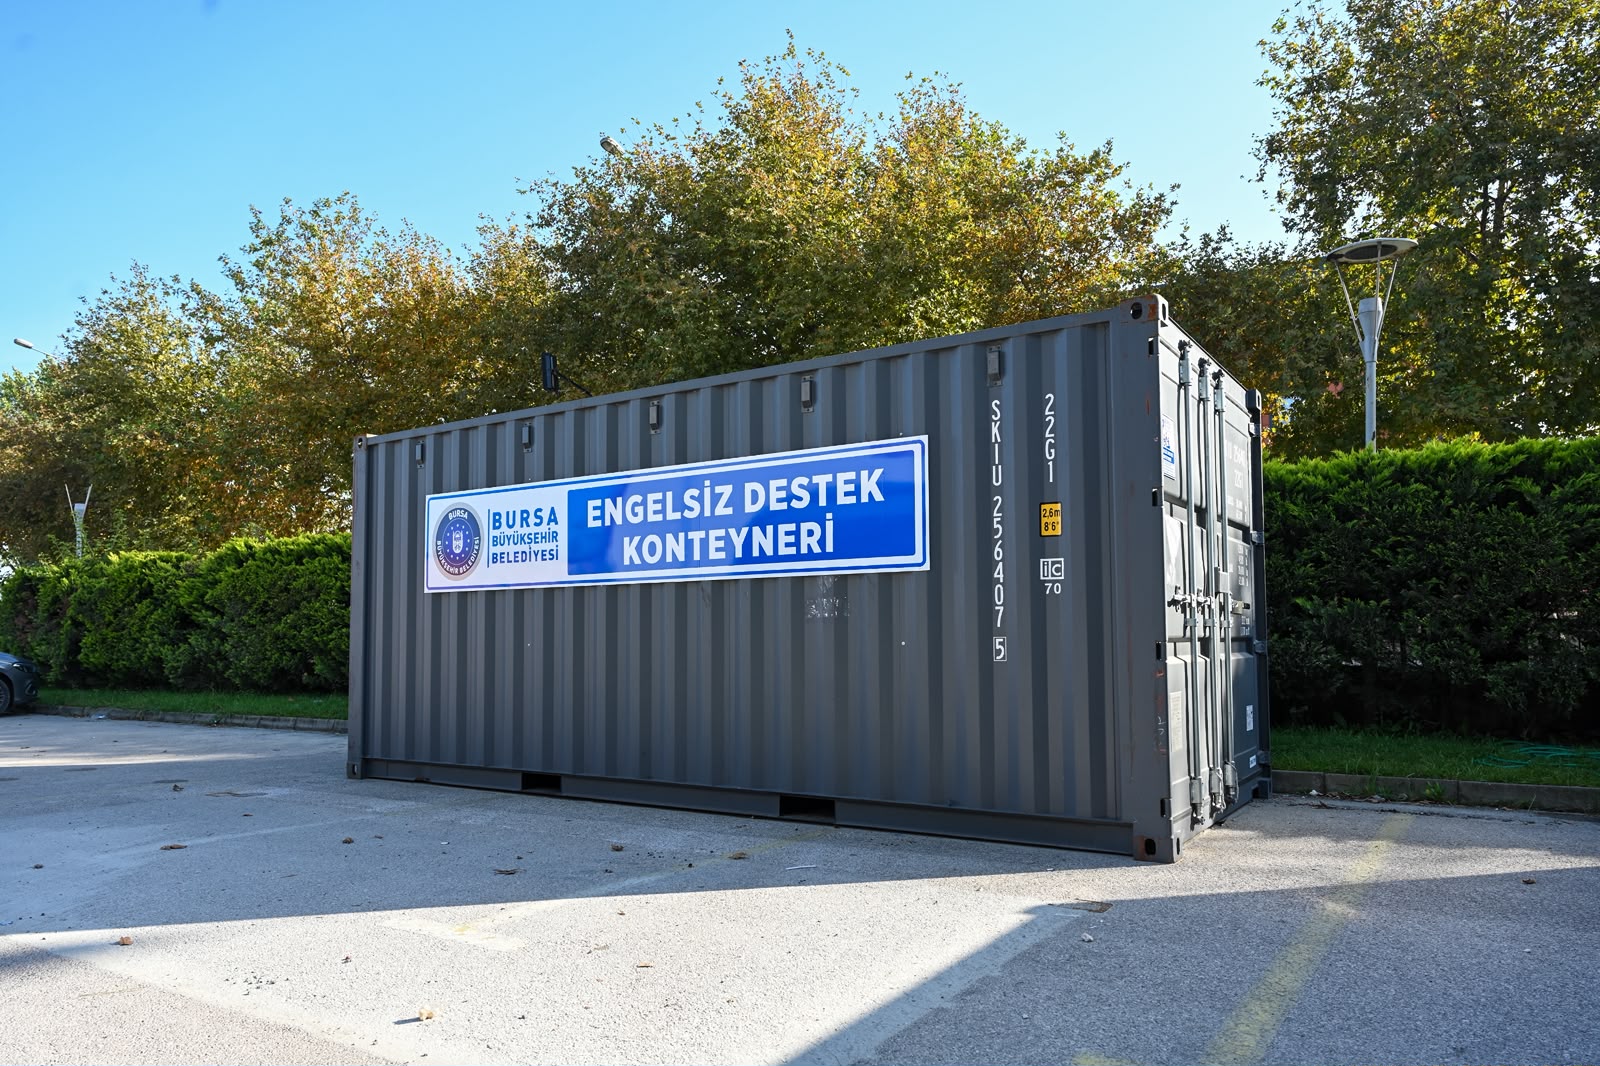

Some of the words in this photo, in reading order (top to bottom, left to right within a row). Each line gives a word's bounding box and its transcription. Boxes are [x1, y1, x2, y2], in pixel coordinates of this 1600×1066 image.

[991, 399, 1002, 487] SKIU
[1045, 393, 1056, 483] 22G1
[448, 509, 468, 520] BURSA
[587, 479, 734, 528] ENGELSİZ
[744, 468, 885, 514] DESTEK
[492, 506, 559, 531] BURSA
[491, 544, 559, 564] BELEDİYESİ
[623, 512, 834, 566] KONTEYNERİ
[993, 495, 1004, 628] 256407
[1044, 582, 1062, 595] 70
[995, 638, 1005, 660] 5
